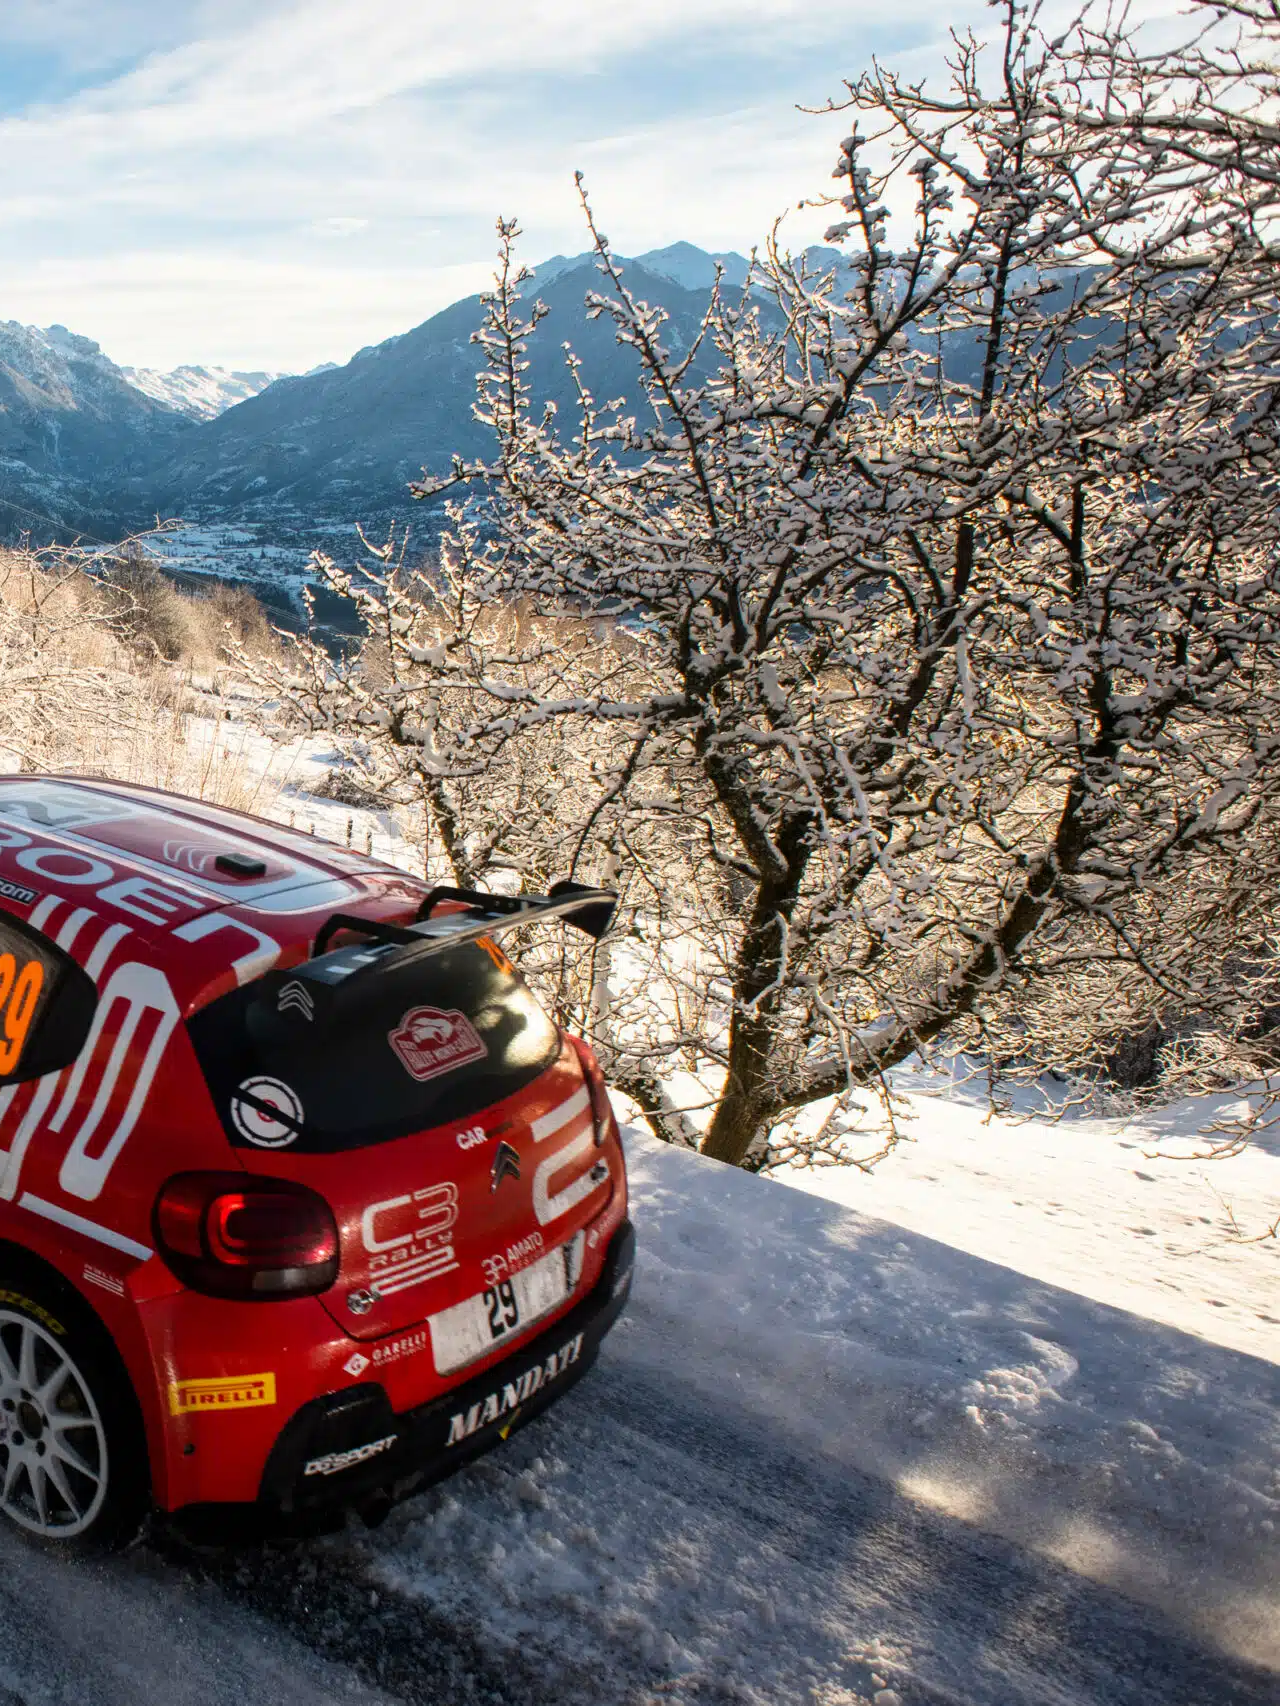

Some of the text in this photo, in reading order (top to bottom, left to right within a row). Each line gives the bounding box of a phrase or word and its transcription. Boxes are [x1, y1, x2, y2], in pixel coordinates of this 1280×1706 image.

[362, 1181, 459, 1253] C3
[506, 1231, 543, 1262] AMATO
[483, 1279, 519, 1338] 29
[178, 1381, 264, 1407] PIRELLI
[445, 1332, 585, 1447] MANDATI
